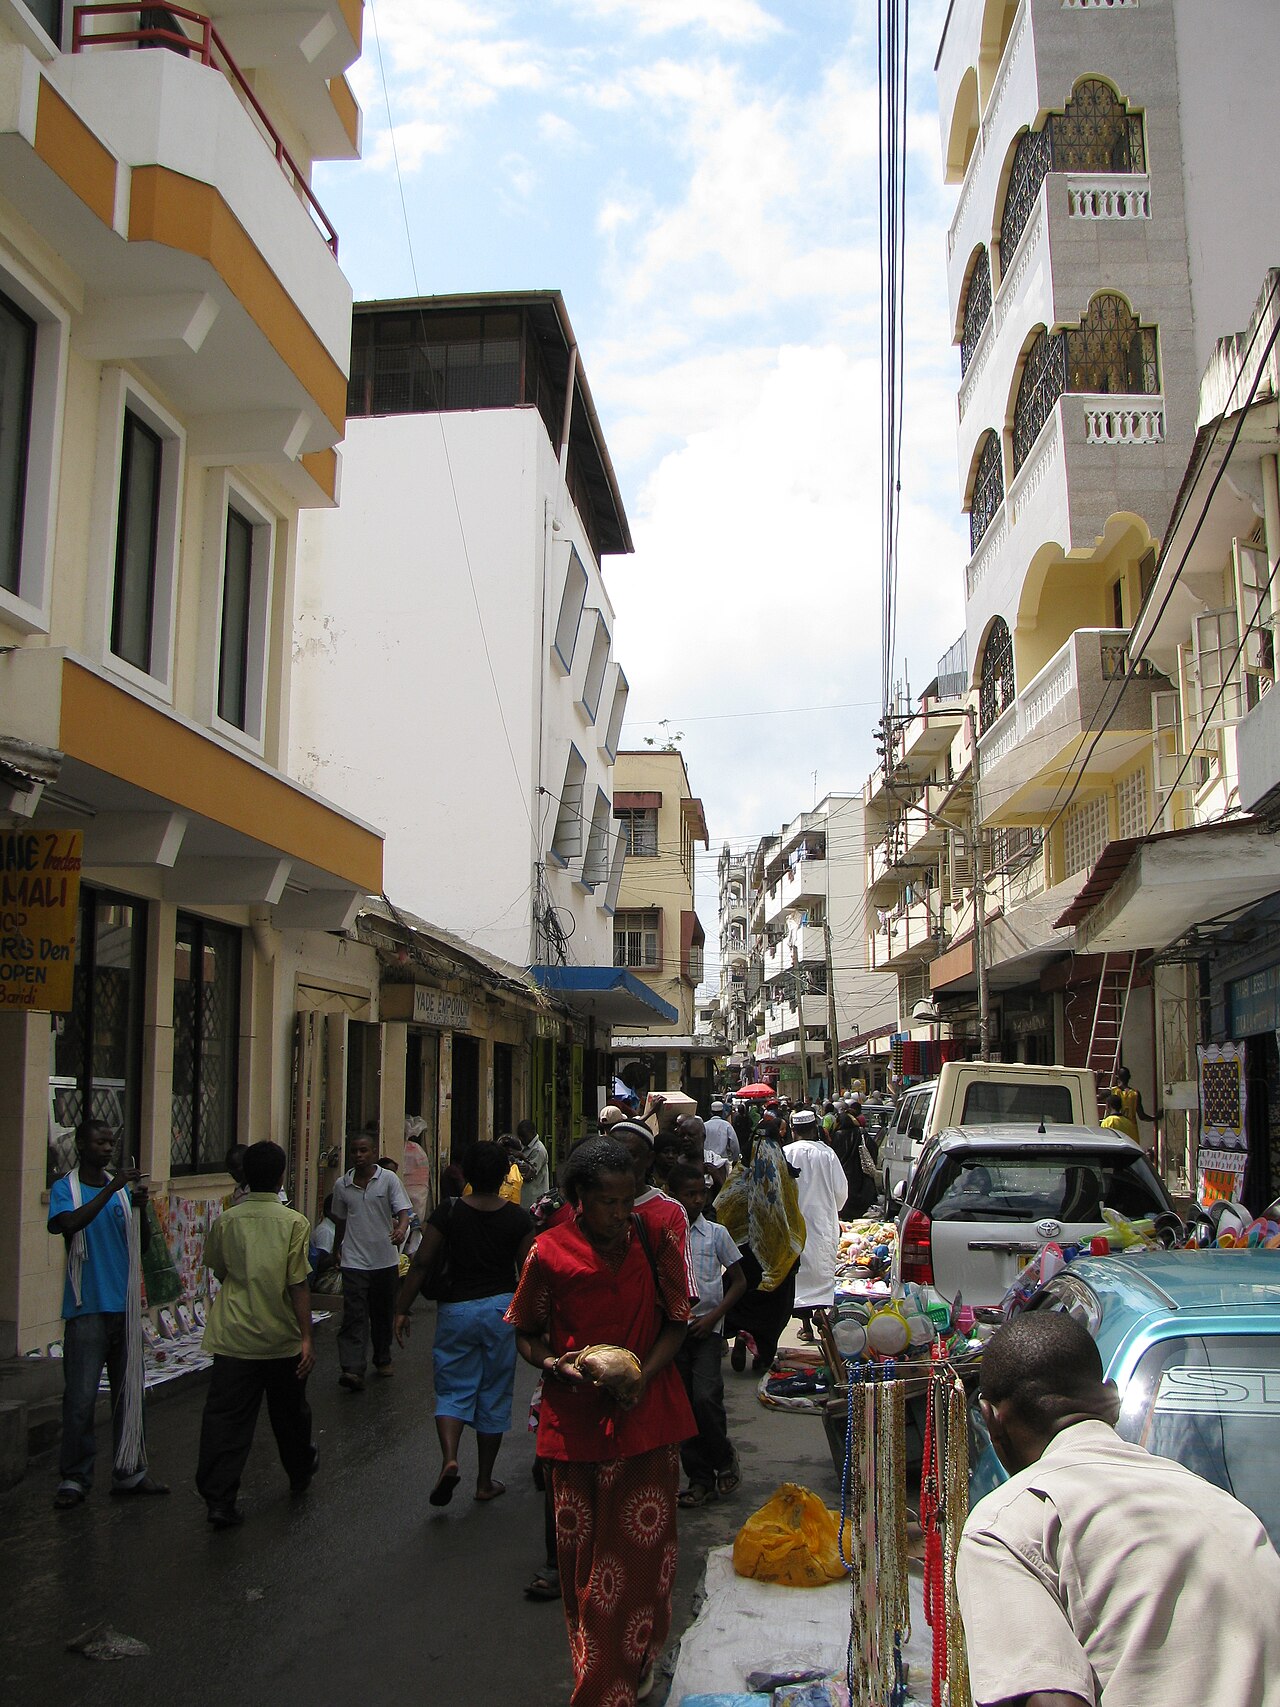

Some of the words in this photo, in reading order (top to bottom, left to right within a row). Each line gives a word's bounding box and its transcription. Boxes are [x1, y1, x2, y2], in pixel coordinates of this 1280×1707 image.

[2, 875, 67, 907] MALI
[0, 910, 28, 932] OP
[0, 964, 47, 984] OPEN
